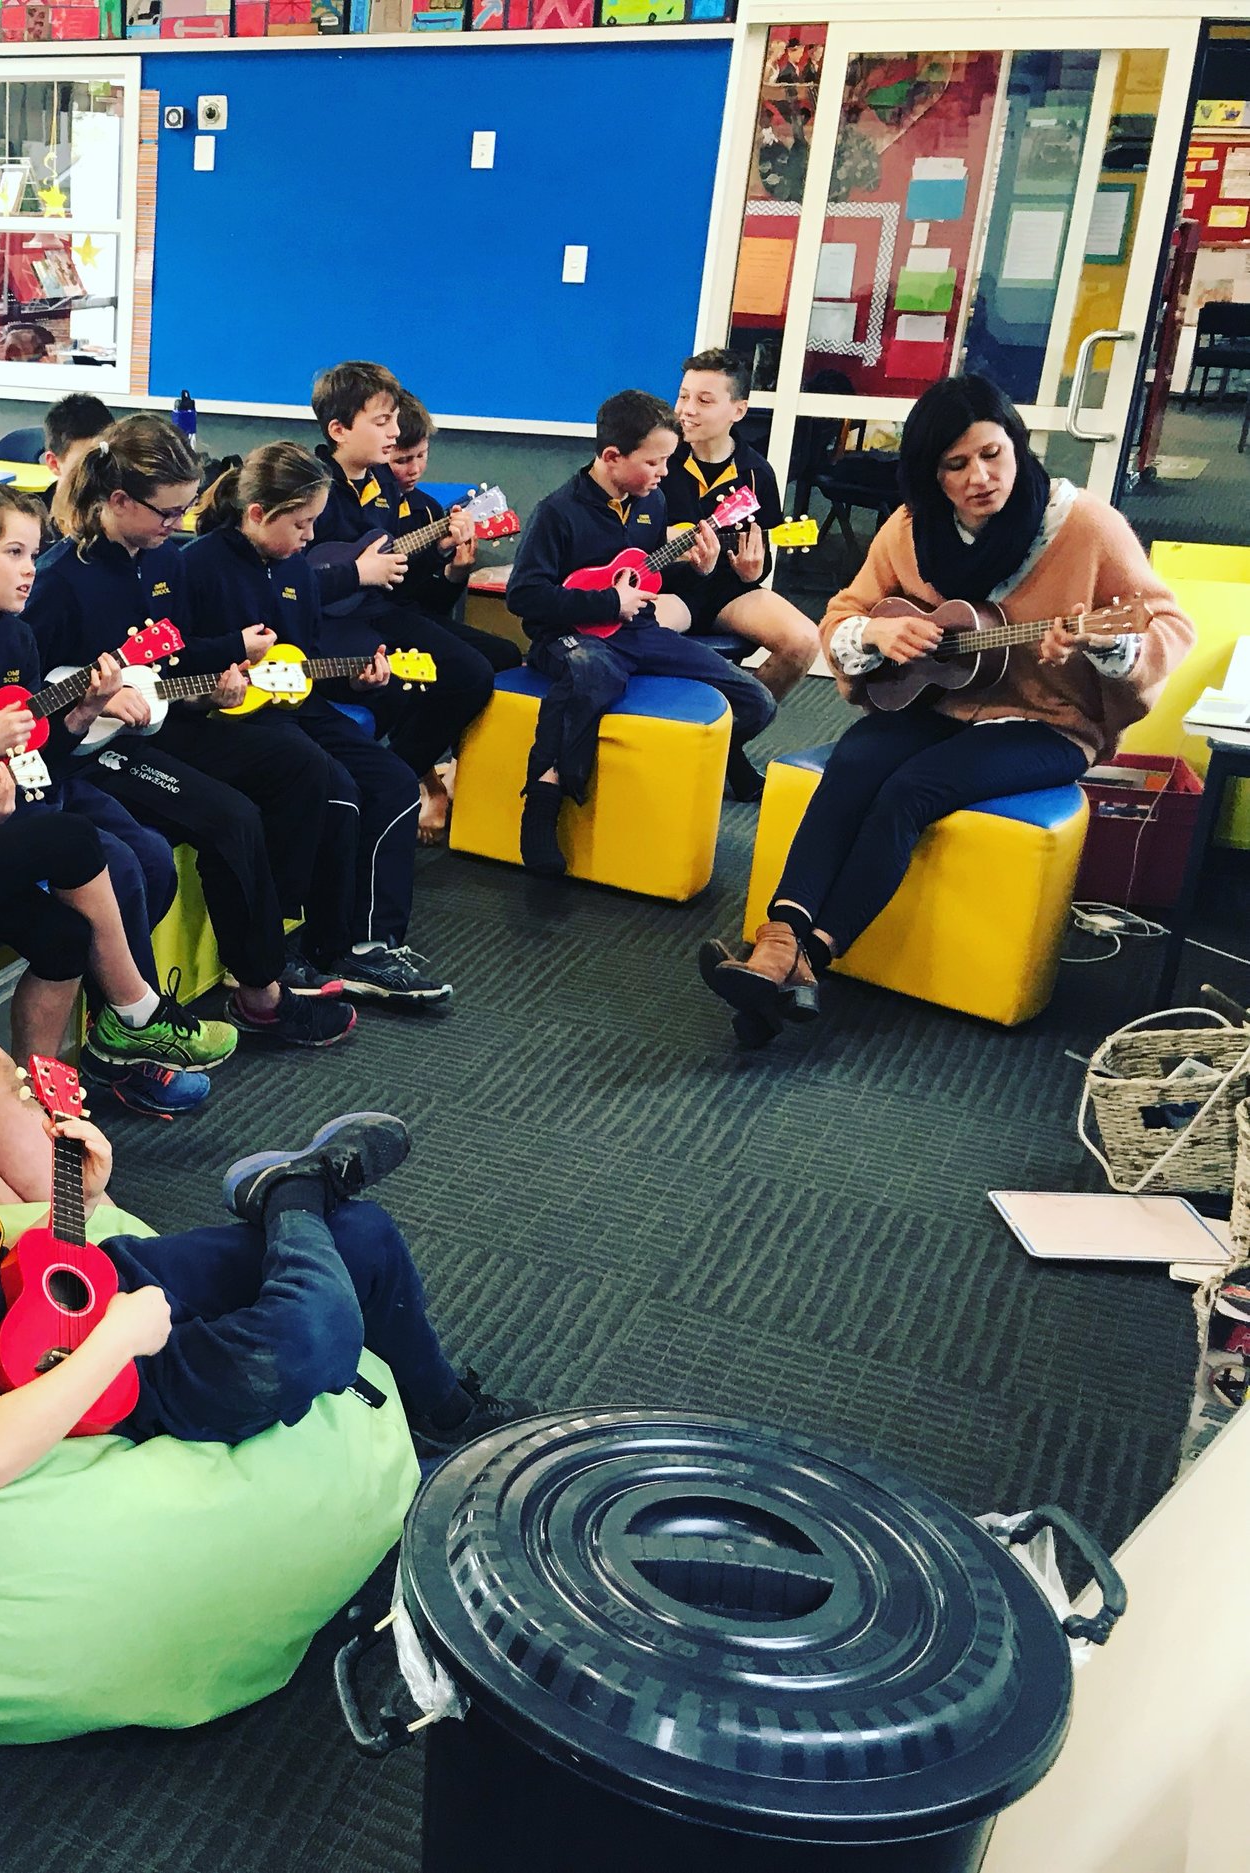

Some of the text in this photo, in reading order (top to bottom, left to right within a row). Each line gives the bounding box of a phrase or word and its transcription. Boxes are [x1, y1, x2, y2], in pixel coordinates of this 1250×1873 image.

[129, 767, 180, 794] OF NEW ZEALAND
[140, 764, 180, 784] CANTERBURY
